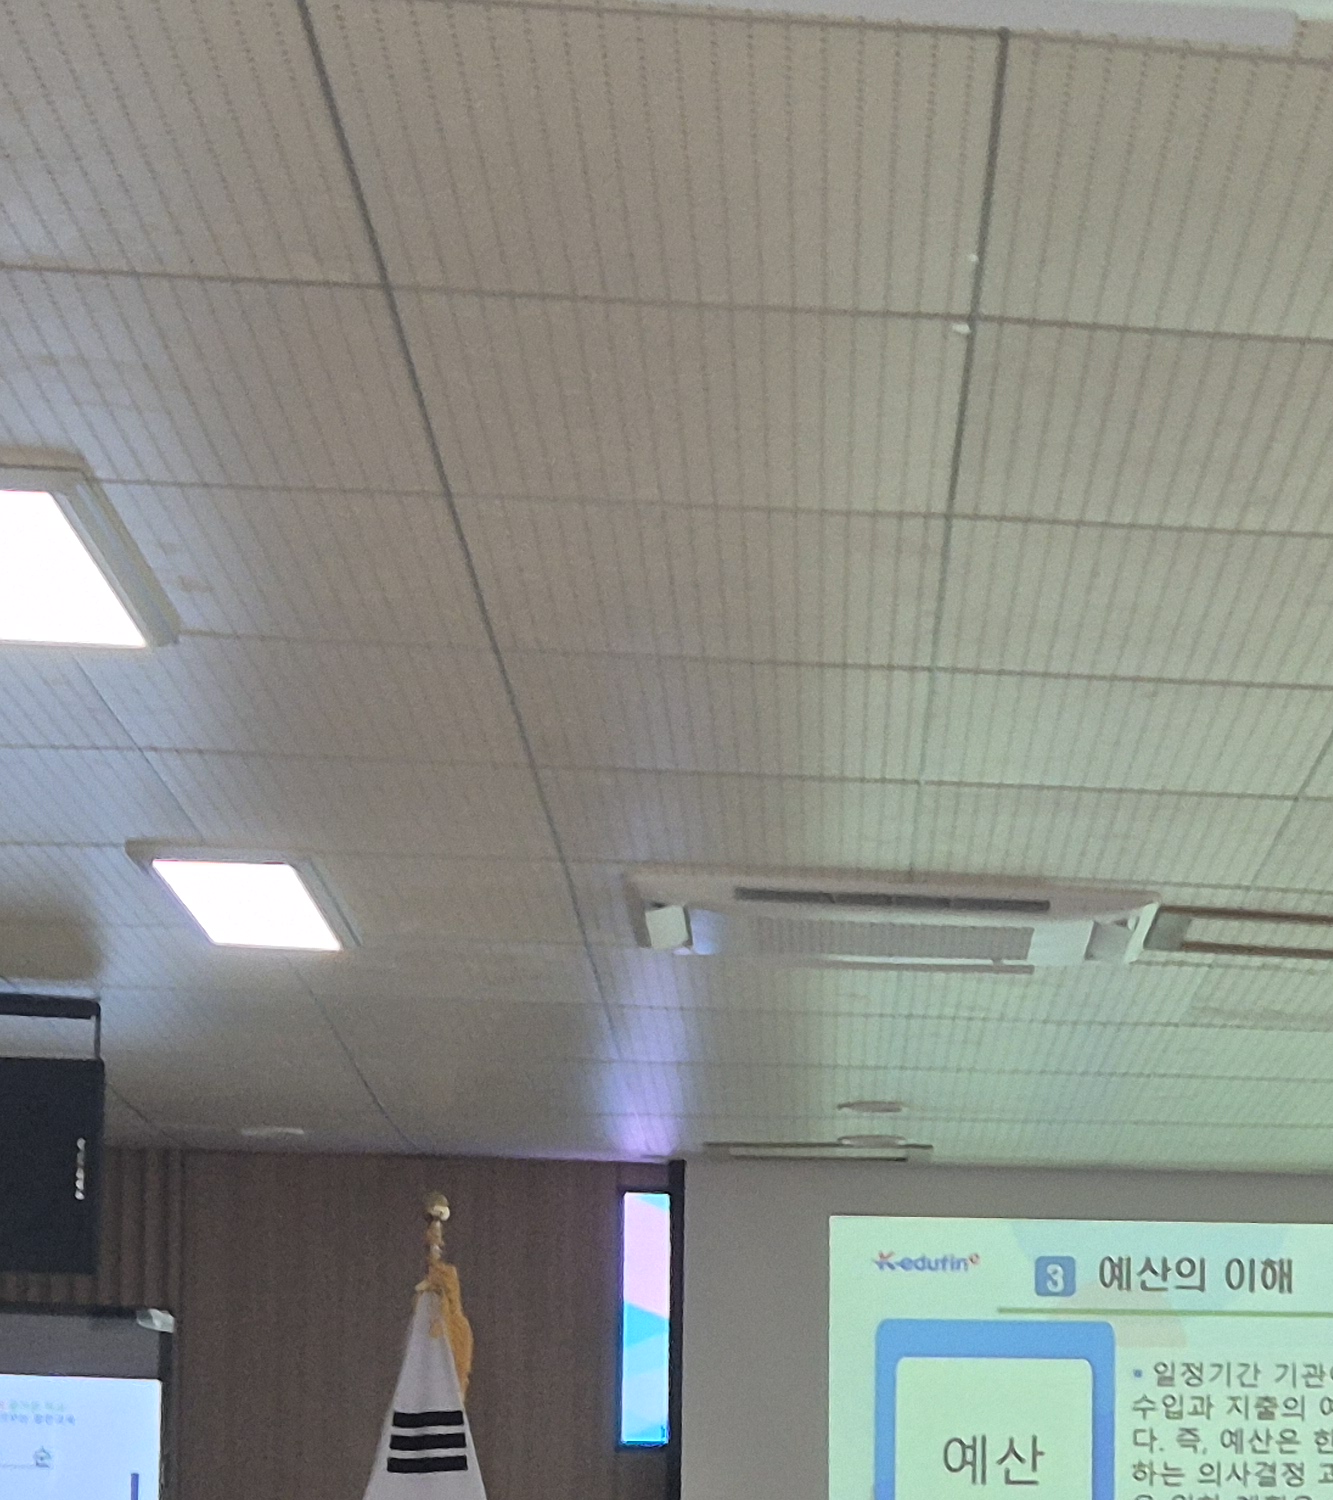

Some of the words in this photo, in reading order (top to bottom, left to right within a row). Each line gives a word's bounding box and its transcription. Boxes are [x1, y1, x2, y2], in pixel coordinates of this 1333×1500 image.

[1045, 1263, 1066, 1294] 3
[1099, 1254, 1207, 1294] 예산의
[1224, 1256, 1294, 1295] 이해
[1153, 1361, 1262, 1388] 일정기간
[1132, 1394, 1214, 1421] 수입과
[1226, 1395, 1306, 1422] 지출의
[1132, 1427, 1166, 1454] 다.
[1220, 1427, 1302, 1454] 예산은
[941, 1432, 1046, 1490] 예산
[1132, 1460, 1186, 1488] 하는
[1197, 1461, 1306, 1488] 의사결정
